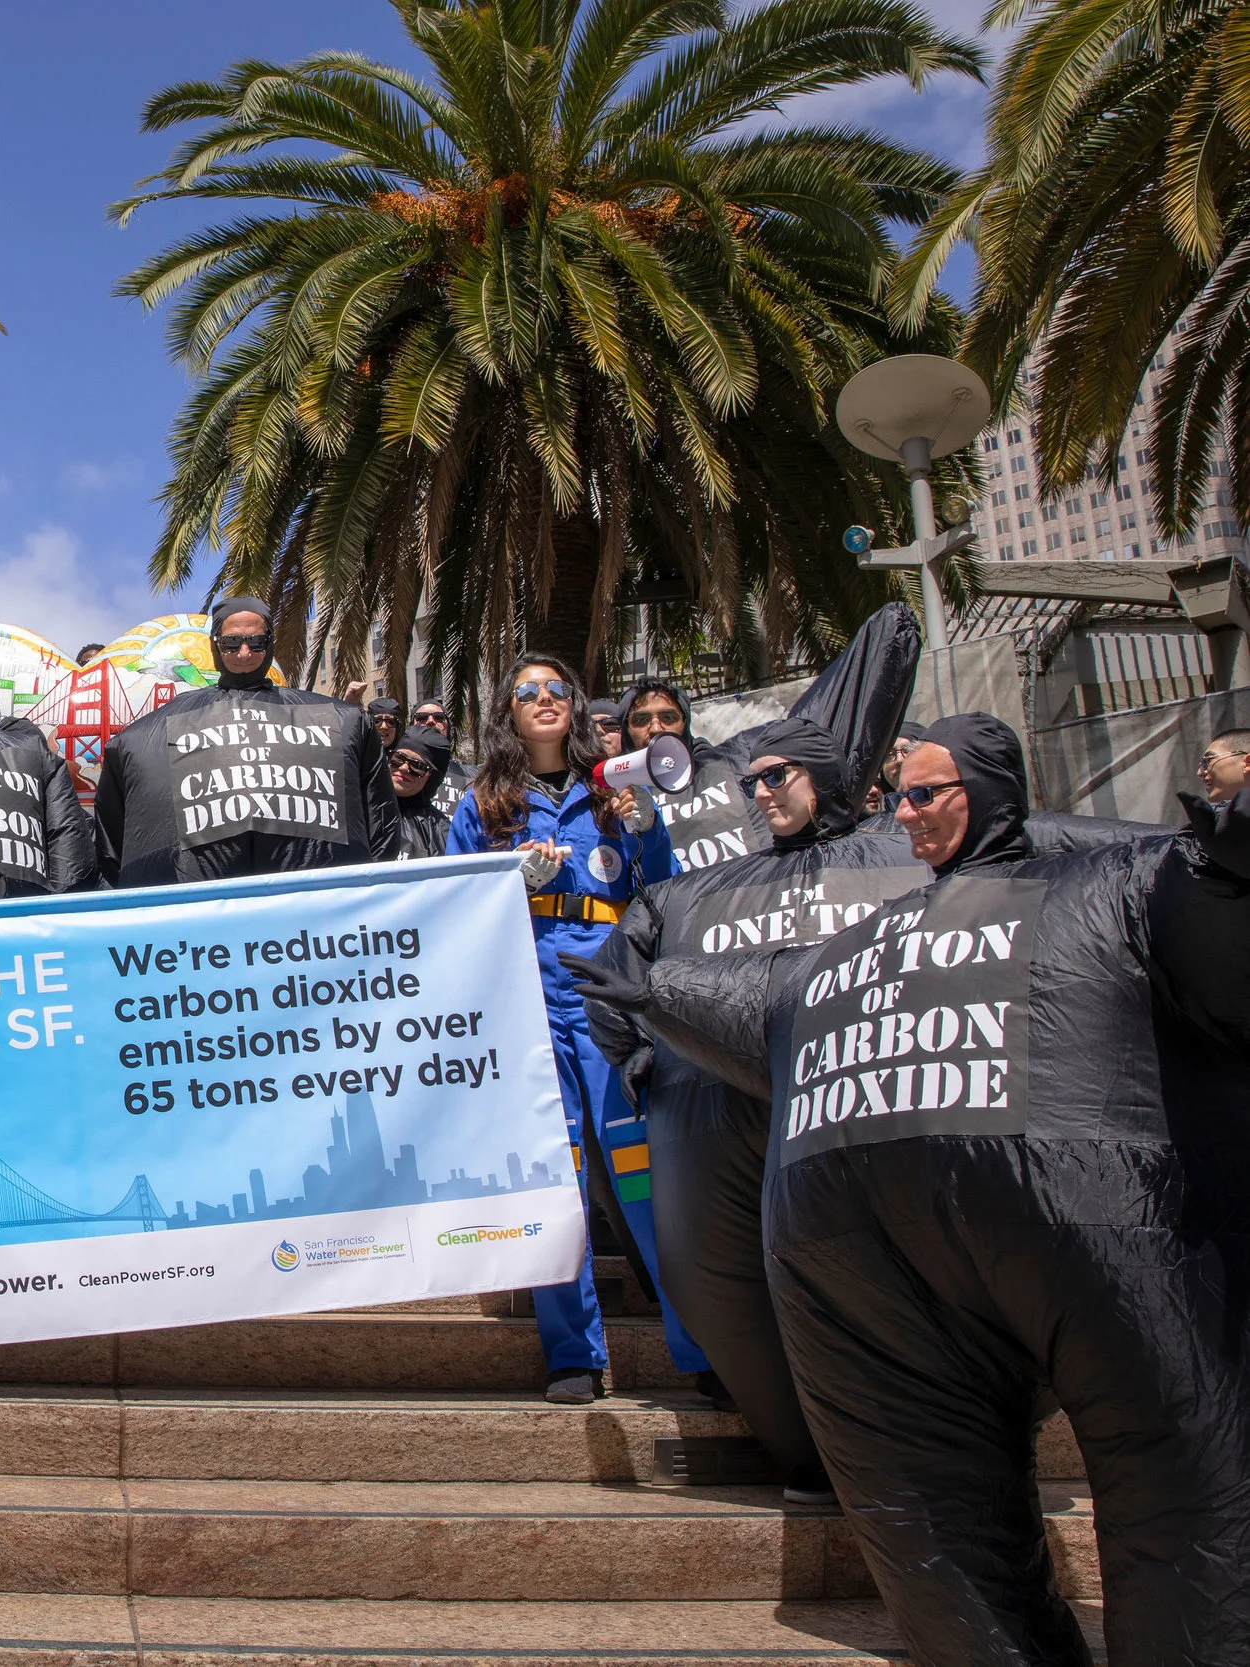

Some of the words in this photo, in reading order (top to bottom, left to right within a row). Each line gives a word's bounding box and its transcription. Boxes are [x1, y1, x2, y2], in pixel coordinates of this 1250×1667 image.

[176, 723, 250, 754] ONE
[266, 724, 331, 747] TON
[240, 747, 271, 762] OF
[180, 764, 336, 800] CARBON
[614, 761, 630, 772] PYLE
[183, 792, 339, 834] DIOXIDE
[673, 827, 748, 872] BON
[244, 924, 421, 967] reducing
[702, 908, 796, 954] ONE
[810, 902, 883, 937] TO
[805, 942, 887, 1009] ONE
[897, 920, 1022, 974] TON
[114, 985, 259, 1024] carbon
[271, 967, 421, 1008] dioxide
[861, 980, 904, 1015] OF
[7, 1004, 85, 1051] SF.
[119, 1025, 321, 1069] emissions
[332, 1017, 382, 1054] by
[396, 1010, 484, 1043] over
[795, 1001, 1011, 1087] CARBON
[123, 1079, 175, 1115] 65
[188, 1076, 279, 1109] tons
[291, 1063, 404, 1100] every
[417, 1048, 502, 1089] day!
[786, 1059, 1009, 1141] DIOXIDE
[304, 1240, 324, 1250] San
[326, 1235, 376, 1248] Francisco
[305, 1250, 337, 1261] Water
[338, 1246, 371, 1257] Power
[372, 1243, 405, 1254] Sewer
[437, 1222, 543, 1247] CleanPowerSF
[78, 1263, 216, 1288] CleanPowerSF.org
